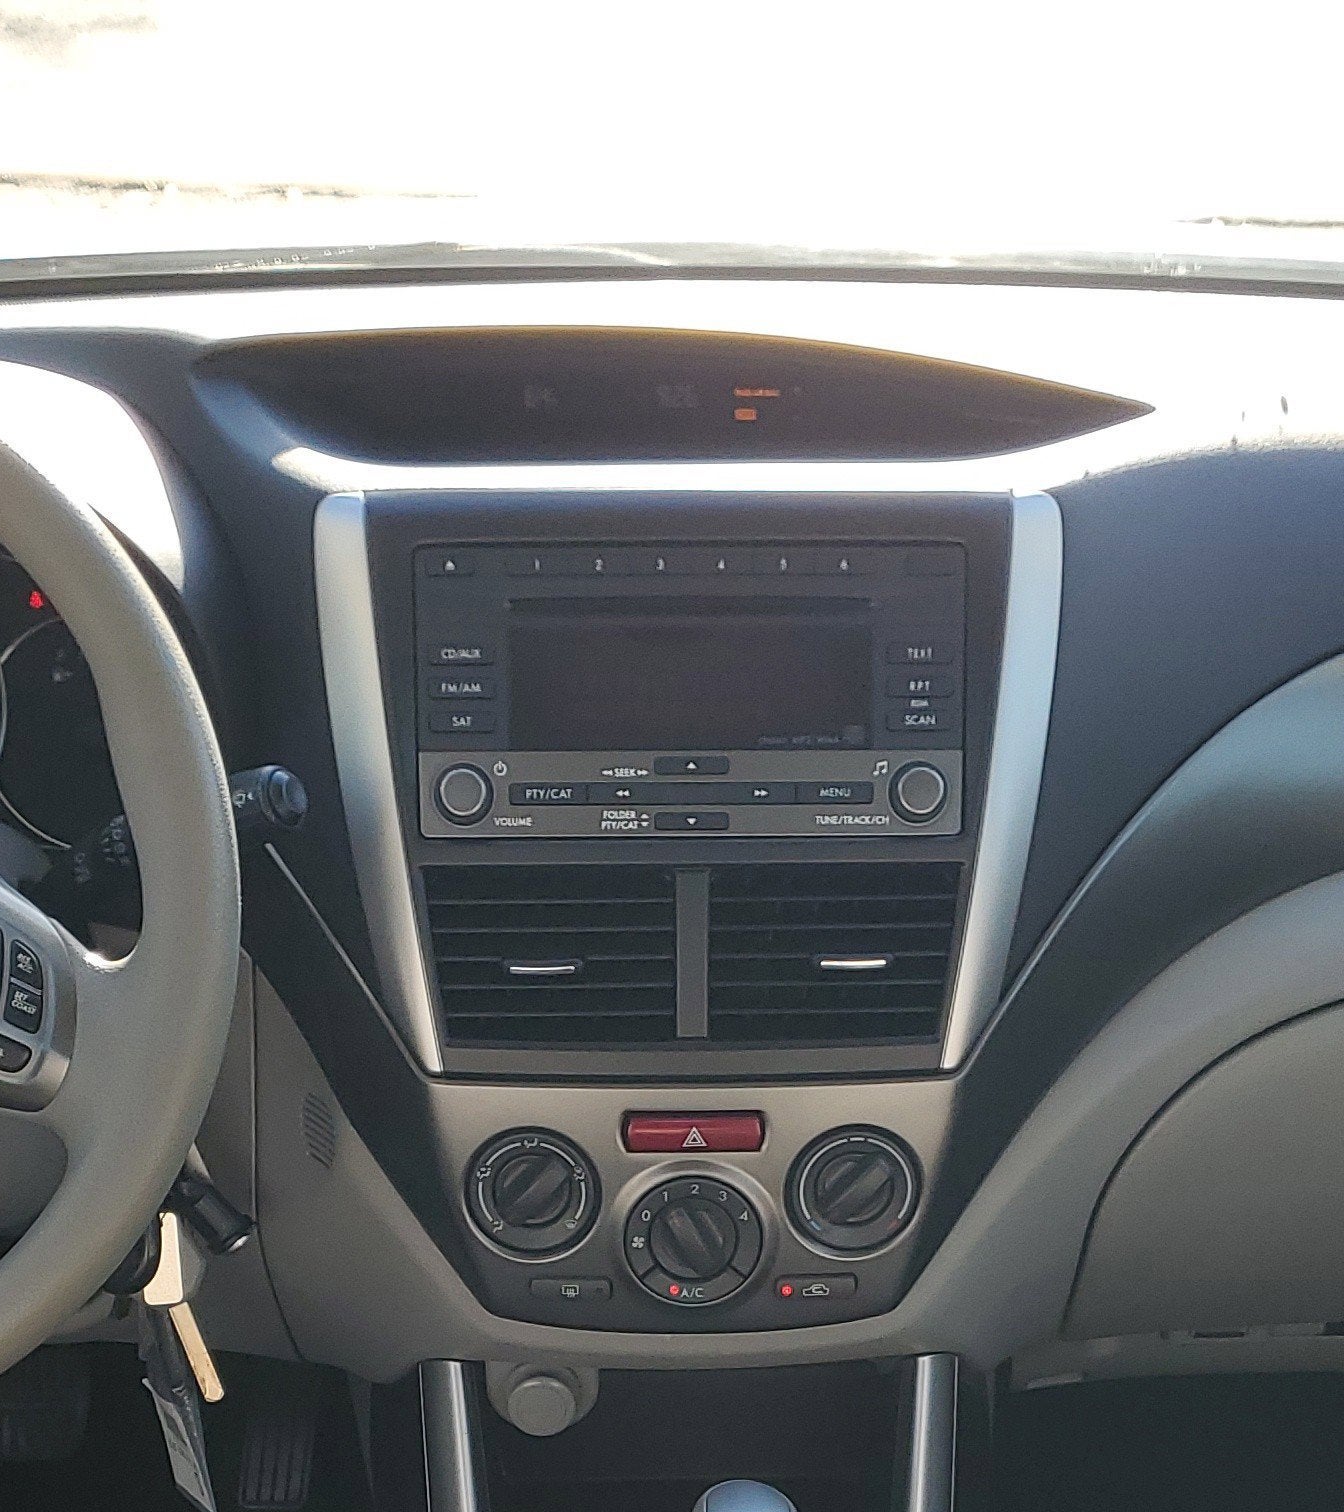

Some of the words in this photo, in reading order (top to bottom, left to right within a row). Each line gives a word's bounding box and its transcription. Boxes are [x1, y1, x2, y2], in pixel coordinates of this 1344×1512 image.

[441, 682, 482, 693] FM/AM
[451, 715, 472, 727] SAT
[905, 714, 936, 725] SCAN
[614, 768, 637, 777] SEEK
[525, 788, 573, 800] PTY/CAT
[819, 787, 851, 797] MENU
[603, 810, 637, 819] FOLDER
[815, 814, 890, 825] TUNE/TRACK/CH
[494, 817, 533, 827] VOLUME
[601, 820, 639, 830] PTY/CAT
[690, 1184, 700, 1194] 2
[662, 1191, 668, 1202] 1
[719, 1191, 728, 1201] 3
[642, 1210, 651, 1221] 0
[738, 1210, 748, 1221] 4
[680, 1288, 704, 1298] A/C
